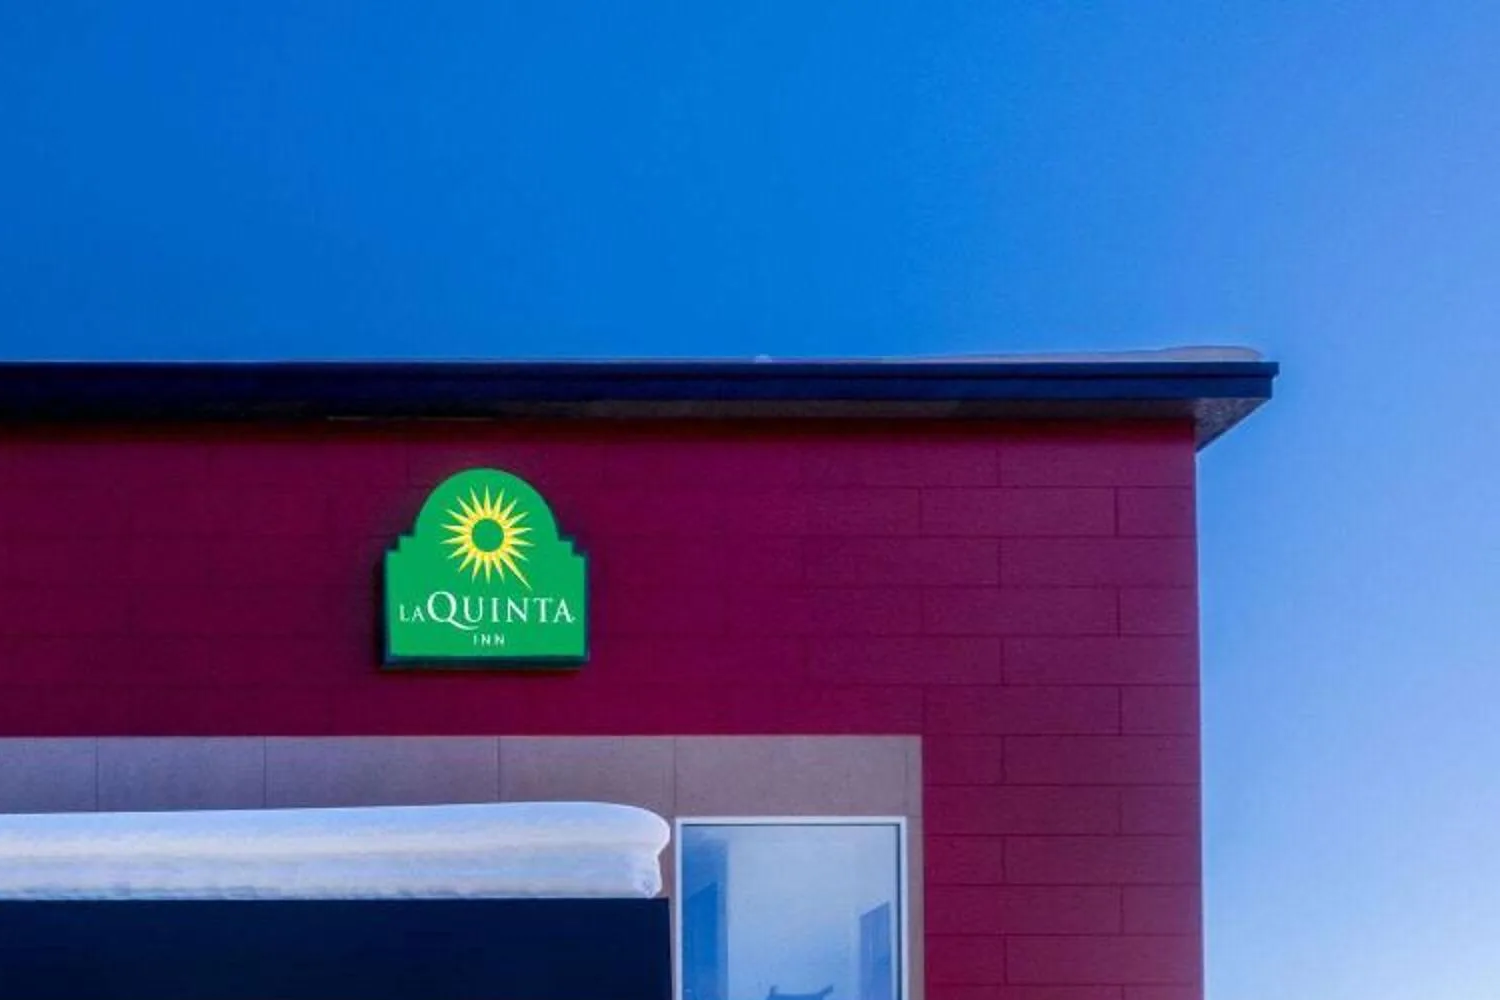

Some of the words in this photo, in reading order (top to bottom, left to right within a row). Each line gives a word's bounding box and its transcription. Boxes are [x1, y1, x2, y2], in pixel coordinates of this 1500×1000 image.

[399, 603, 426, 623] LA
[426, 590, 576, 631] QUINTA
[472, 633, 506, 647] INN
